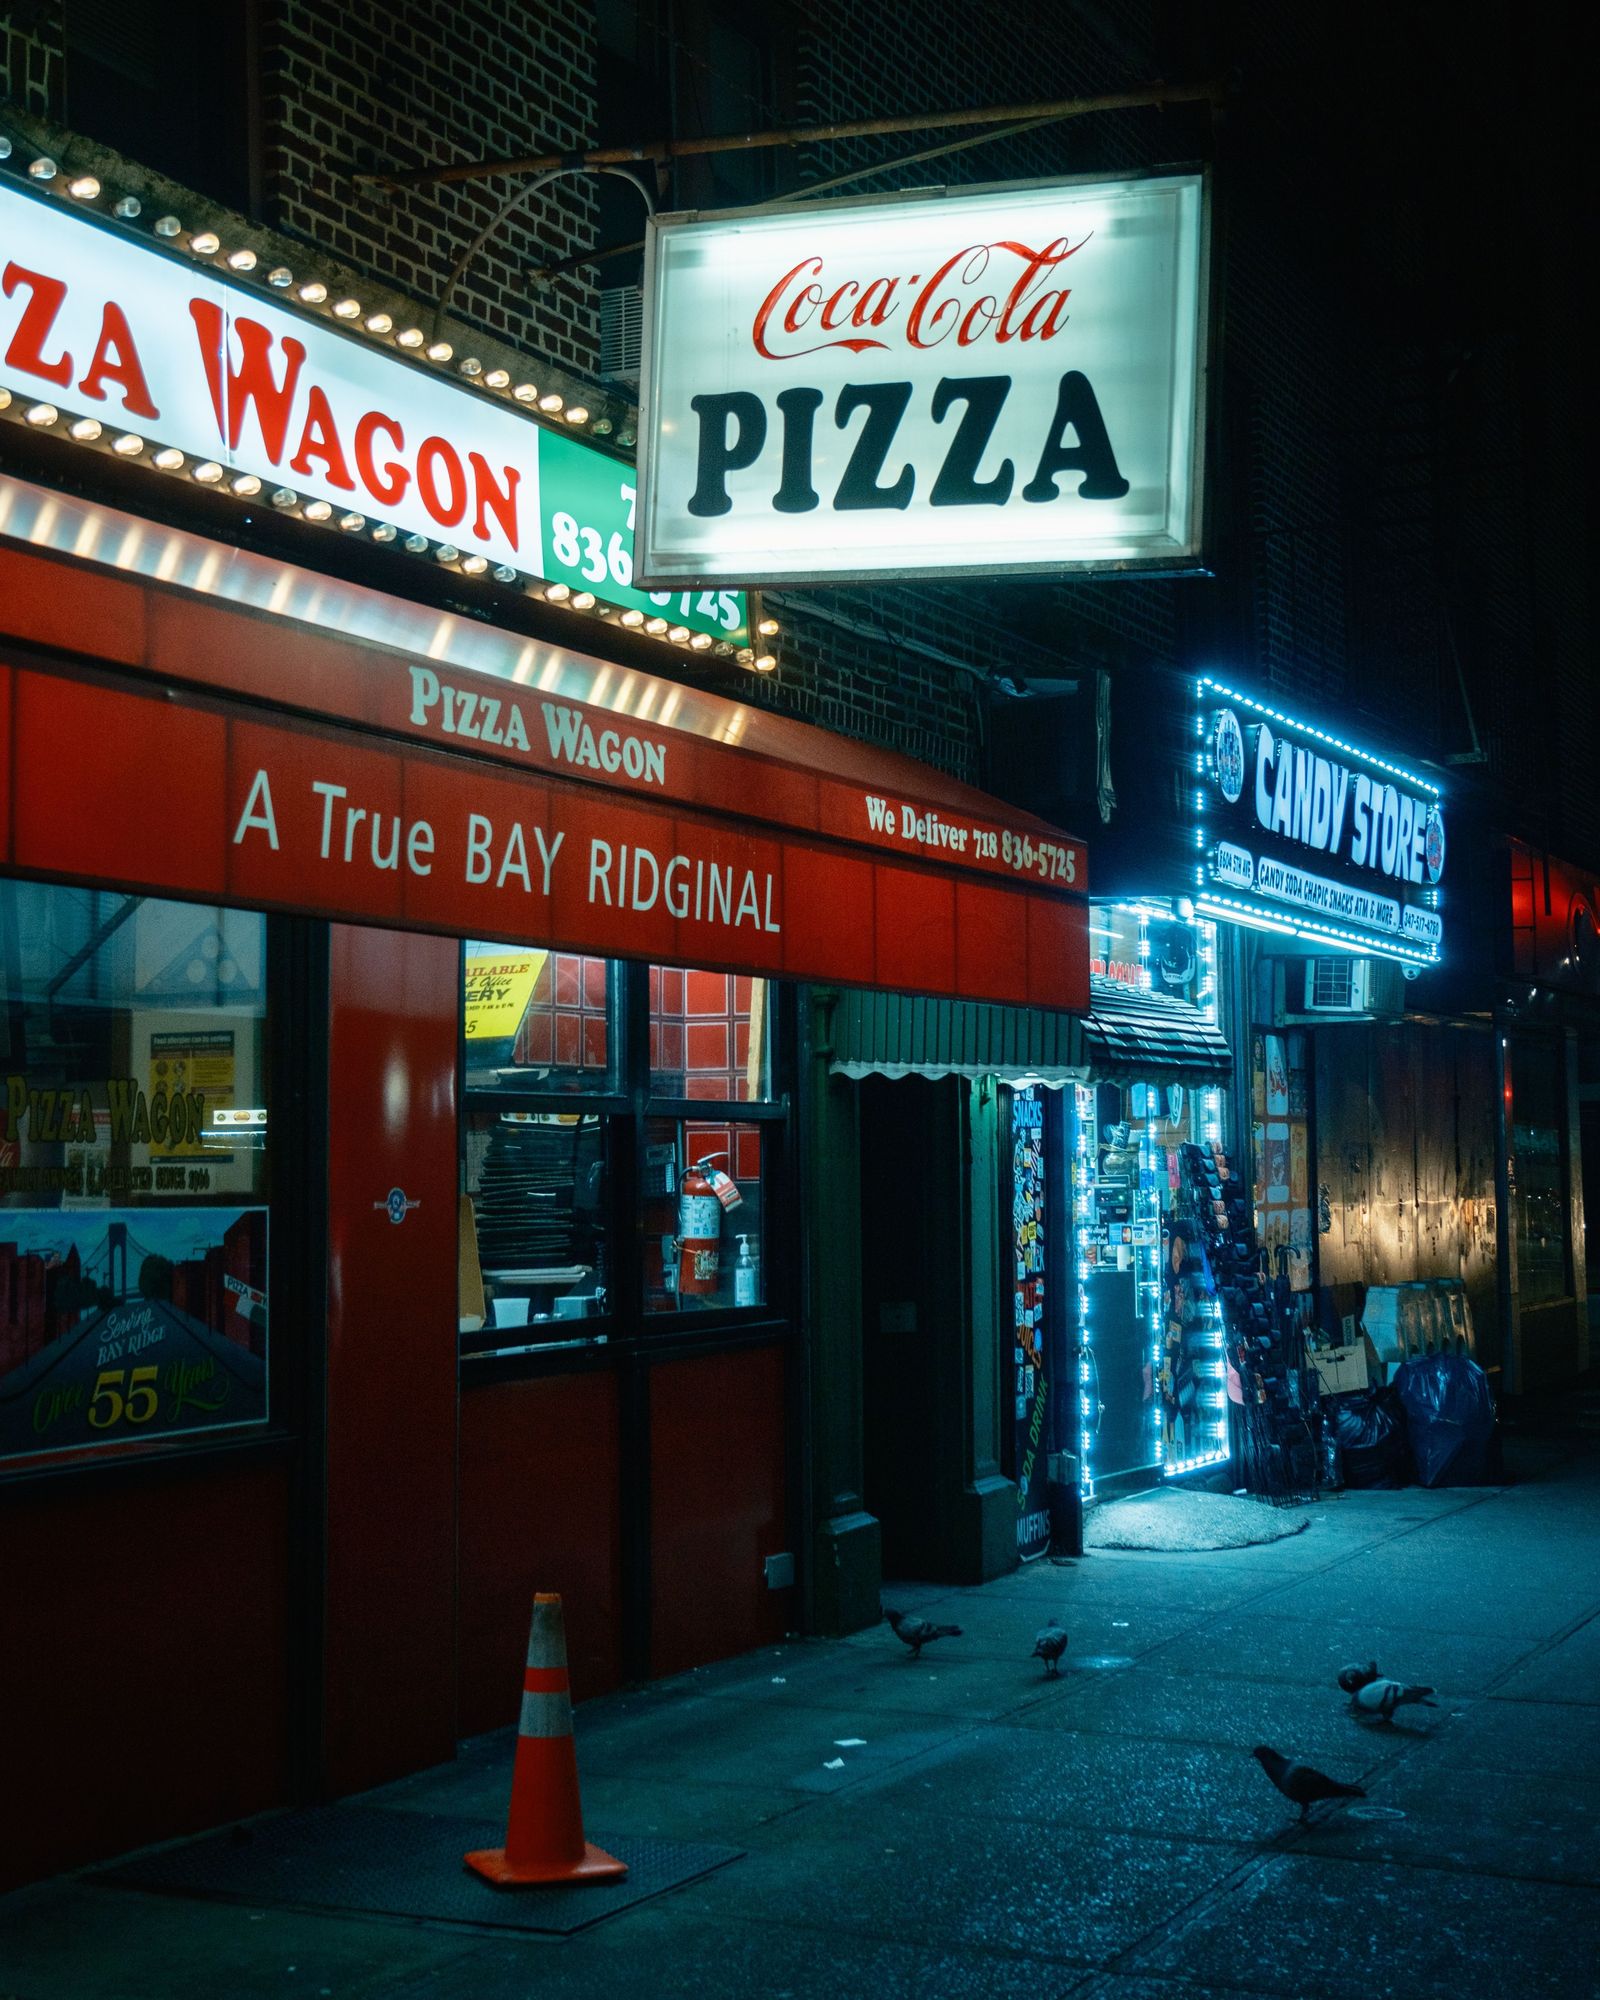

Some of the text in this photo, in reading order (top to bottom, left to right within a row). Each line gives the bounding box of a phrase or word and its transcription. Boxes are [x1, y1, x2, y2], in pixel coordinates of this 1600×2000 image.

[752, 230, 1094, 360] Coca-Cola
[188, 297, 522, 553] WAGON
[687, 369, 1130, 518] PIZZA
[408, 665, 668, 786] PIZZA WAGON
[865, 795, 1076, 883] We Deliver 718 836-5725
[1255, 722, 1427, 884] CANDY STORE
[233, 768, 781, 934] A True BAY RIDGINAL
[1242, 859, 1251, 879] AVE
[1260, 863, 1285, 894] CANDY
[1285, 871, 1302, 898] SODA
[1329, 889, 1354, 915] SNACKS
[1354, 896, 1368, 918] ATM
[1369, 900, 1375, 919] &
[5, 1073, 206, 1145] PIZZA WAGON
[1013, 1101, 1043, 1128] SNACKS
[96, 1324, 167, 1369] BAY RIDGE
[100, 1307, 152, 1343] Serving
[87, 1364, 159, 1430] 55
[1016, 1509, 1051, 1547] MUFFINS
